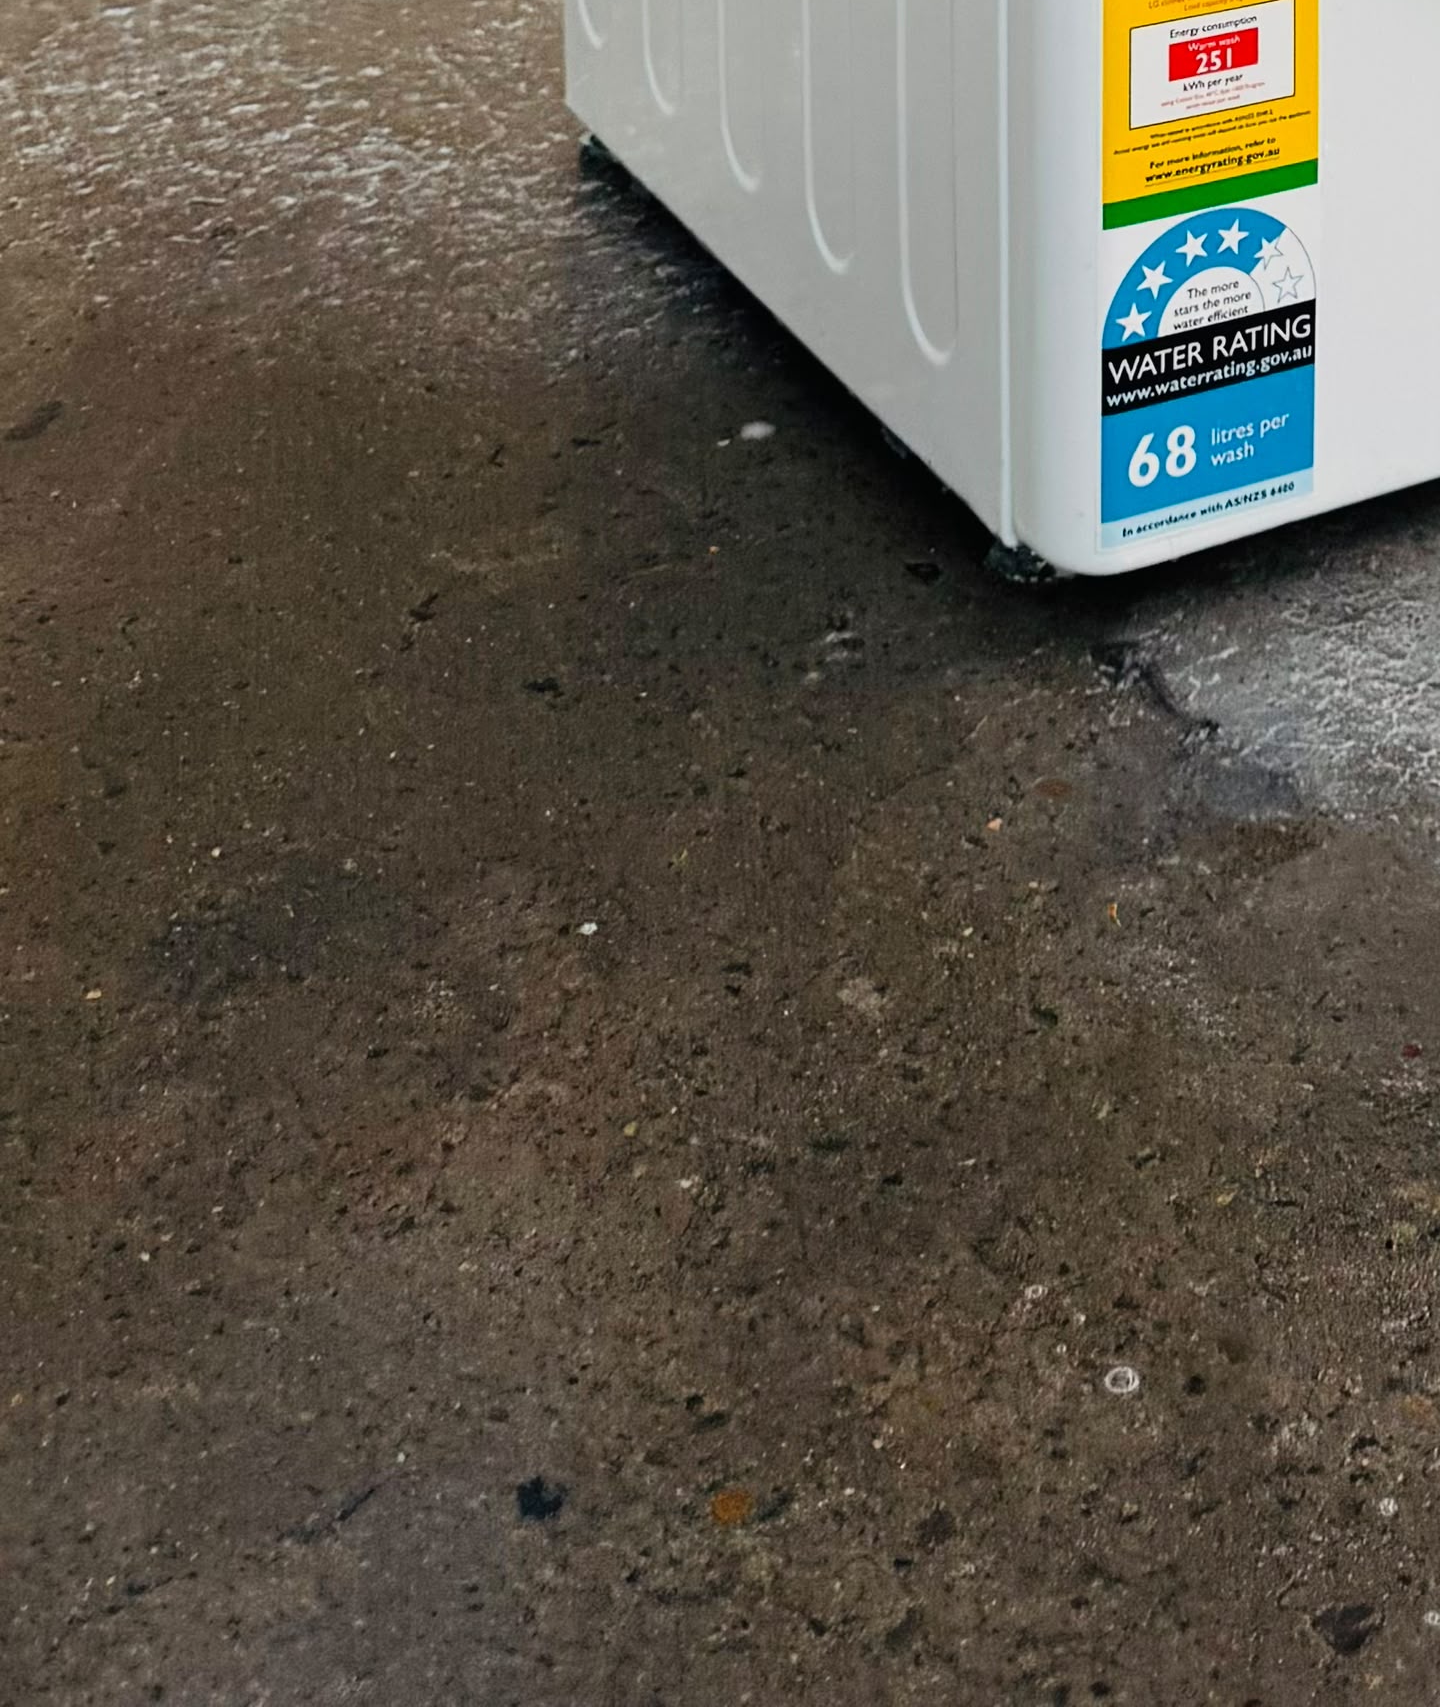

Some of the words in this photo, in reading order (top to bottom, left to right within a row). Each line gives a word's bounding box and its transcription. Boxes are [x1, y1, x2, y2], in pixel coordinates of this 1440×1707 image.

[1170, 25, 1200, 39] Energy
[1202, 15, 1258, 33] consumption
[1188, 38, 1217, 52] Warm
[1219, 35, 1240, 47] wash
[1195, 48, 1233, 75] 251
[1183, 80, 1205, 92] kWh
[1207, 78, 1222, 89] per
[1225, 74, 1243, 86] year
[1145, 147, 1280, 183] www.energyrating.gov.au
[1150, 159, 1165, 170] For
[1167, 155, 1190, 165] more
[1245, 139, 1265, 150] refer
[1267, 137, 1276, 145] to
[1187, 287, 1208, 299] The
[1211, 281, 1239, 294] more
[1174, 304, 1199, 317] stars
[1203, 298, 1220, 310] the
[1223, 291, 1251, 304] more
[1173, 316, 1204, 330] water
[1207, 305, 1249, 322] efficient
[1108, 341, 1204, 385] WATER
[1212, 314, 1311, 361] RATING
[1106, 344, 1312, 407] www.waterrating.gov.au
[1128, 424, 1197, 488] 68
[1211, 422, 1254, 446] litres
[1260, 413, 1290, 438] per
[1210, 441, 1255, 467] wash
[1200, 502, 1223, 516] with
